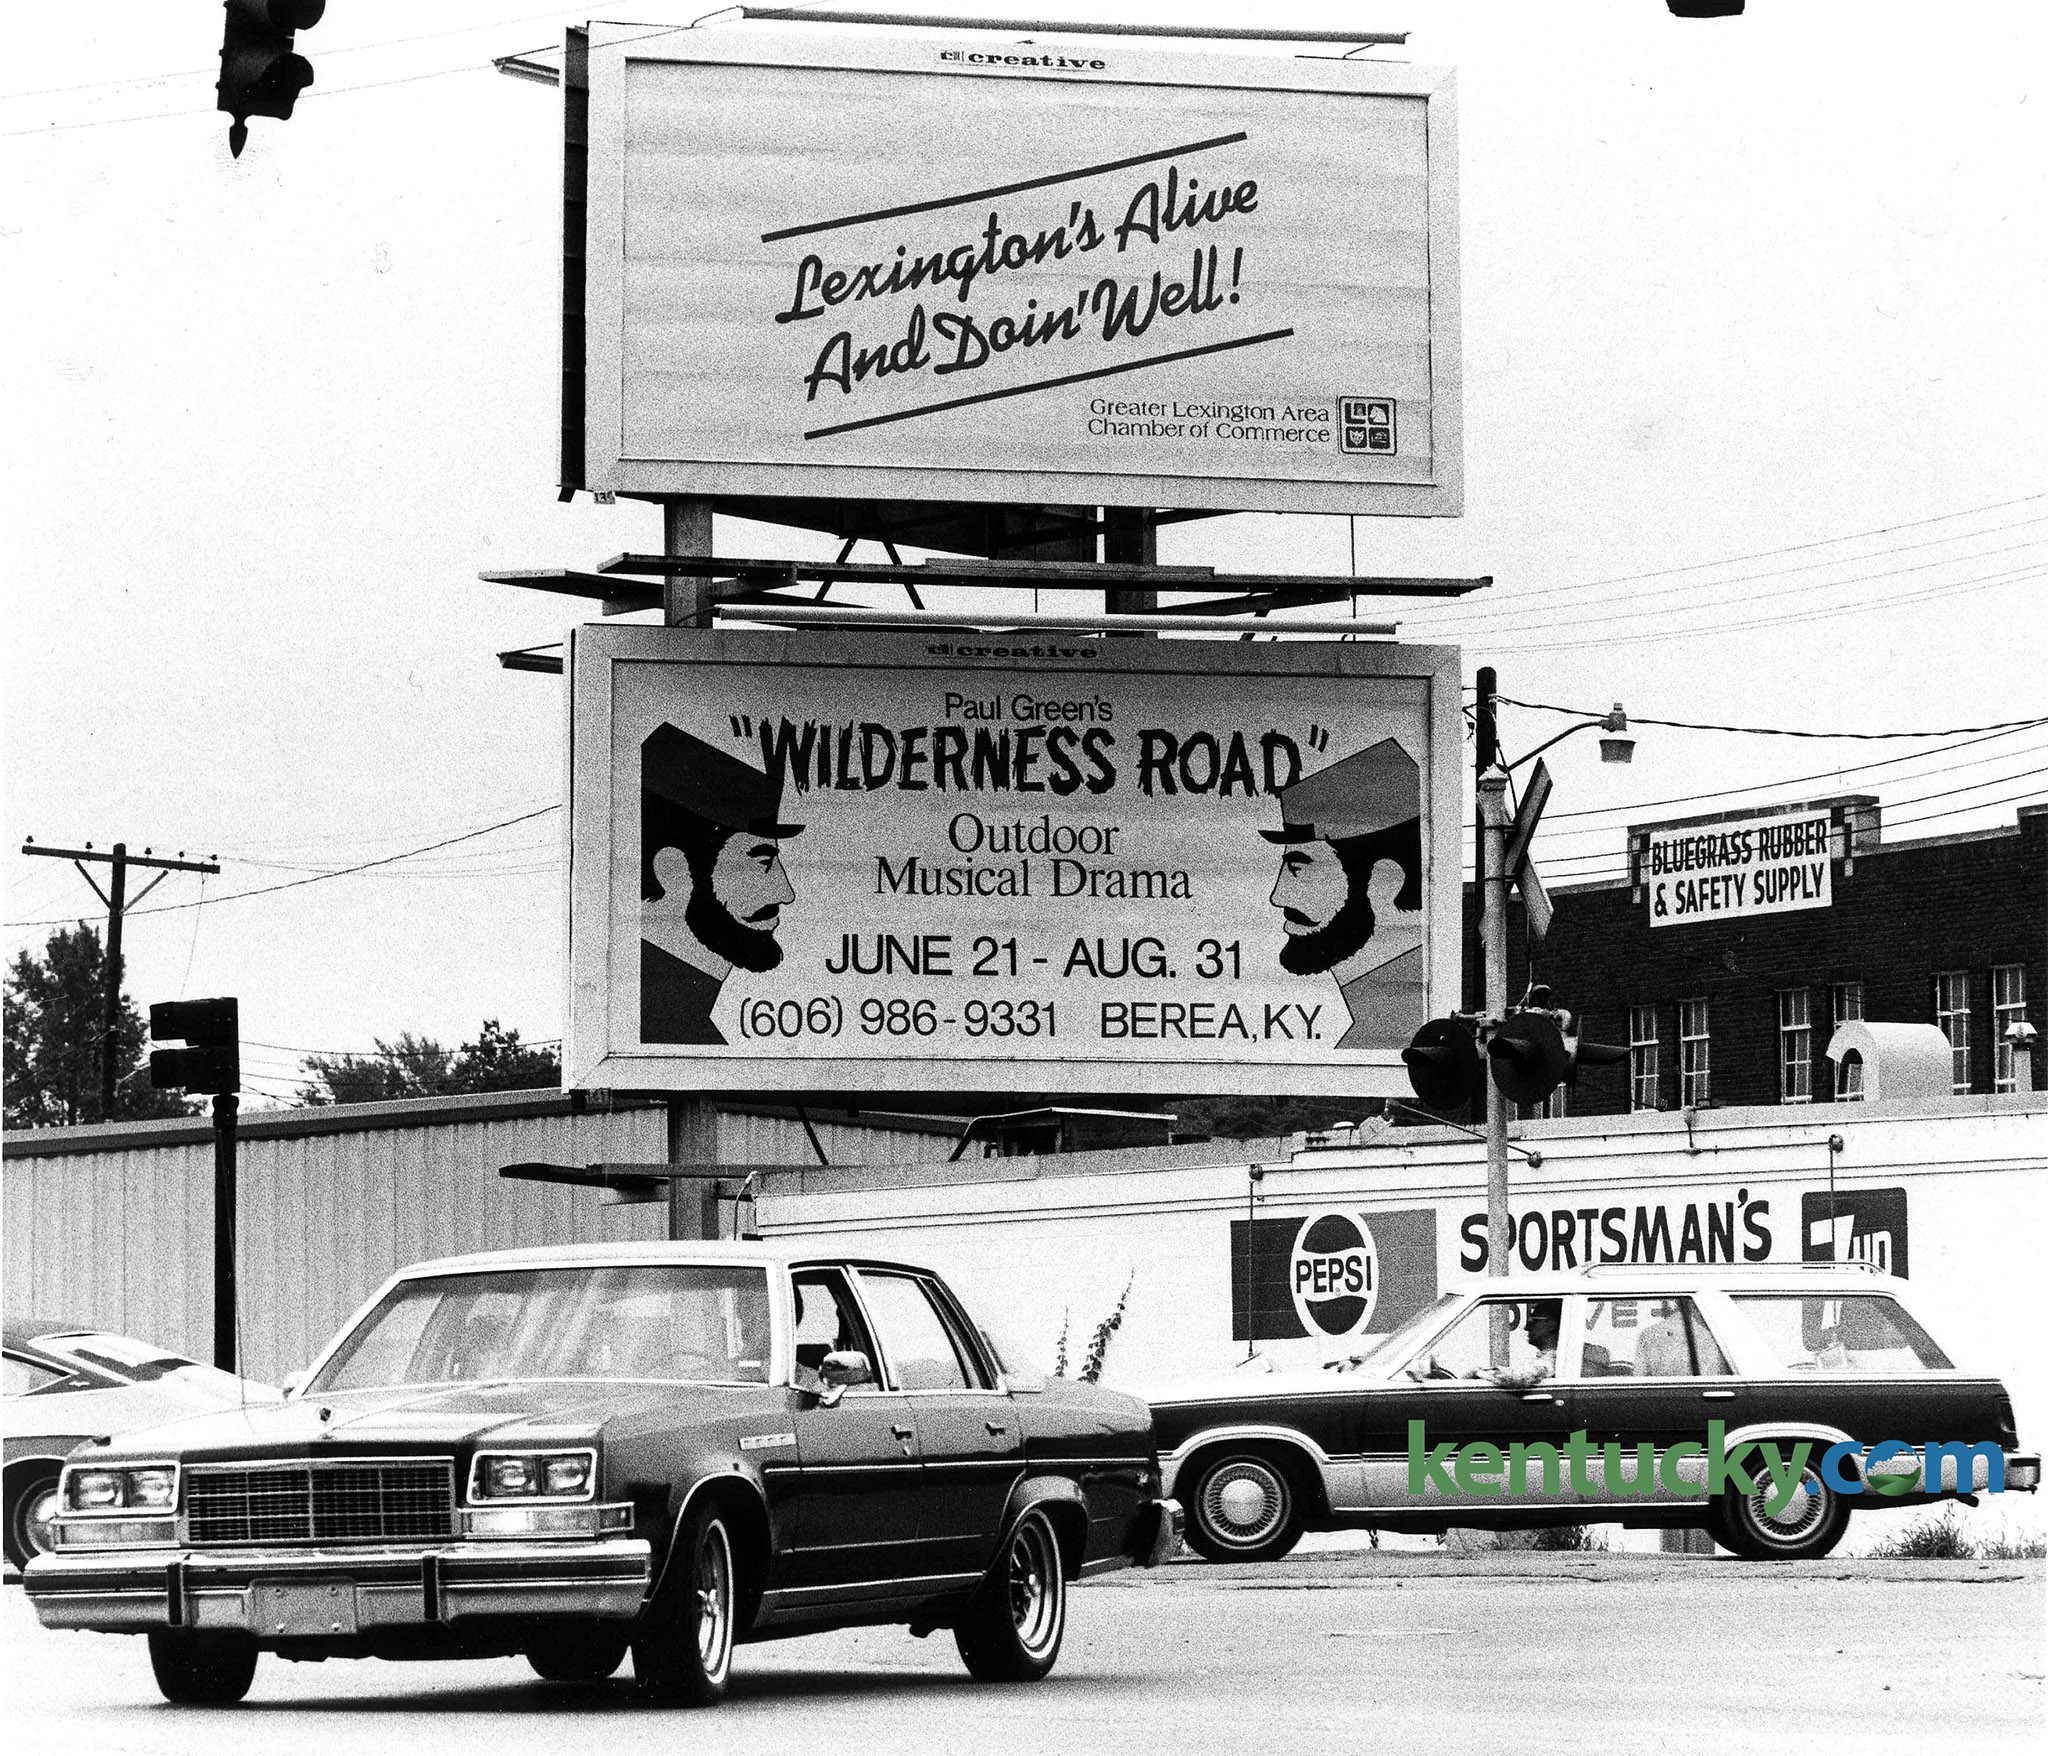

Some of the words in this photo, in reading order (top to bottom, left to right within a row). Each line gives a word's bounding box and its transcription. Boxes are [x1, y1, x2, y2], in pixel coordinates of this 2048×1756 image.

[968, 53, 1106, 70] creative
[775, 201, 1104, 324] Lexington's
[1113, 165, 1258, 253] Alive
[803, 305, 930, 401] And
[932, 289, 1090, 376] Doin'
[1089, 244, 1244, 342] Well!
[1088, 418, 1186, 437] Chamber
[1190, 419, 1211, 438] of
[1215, 422, 1331, 443] Commerce
[1090, 398, 1168, 416] Greater
[1172, 400, 1276, 423] Lexington
[1281, 405, 1330, 422] Area
[944, 692, 1002, 720] Paul
[1010, 694, 1114, 722] Green's
[729, 713, 1117, 797] "WILDERNESS
[1138, 723, 1330, 799] ROAD"
[947, 811, 1120, 856] Outdoor
[1652, 829, 1752, 876] BLUEGRASS
[1758, 818, 1828, 862] RUBBER
[874, 854, 1030, 897] Musical
[1052, 858, 1193, 899] Drama
[1654, 882, 1669, 918] &
[1675, 872, 1747, 915] SAFETY
[1753, 862, 1825, 905] SUPPLY
[825, 933, 953, 975] JUNE
[971, 936, 1018, 977] 21
[1063, 936, 1178, 979] AUG.
[1195, 940, 1242, 980] 31
[739, 995, 843, 1039] (606)
[859, 999, 1057, 1038] 986-9331
[1296, 1254, 1372, 1294] PEPSI
